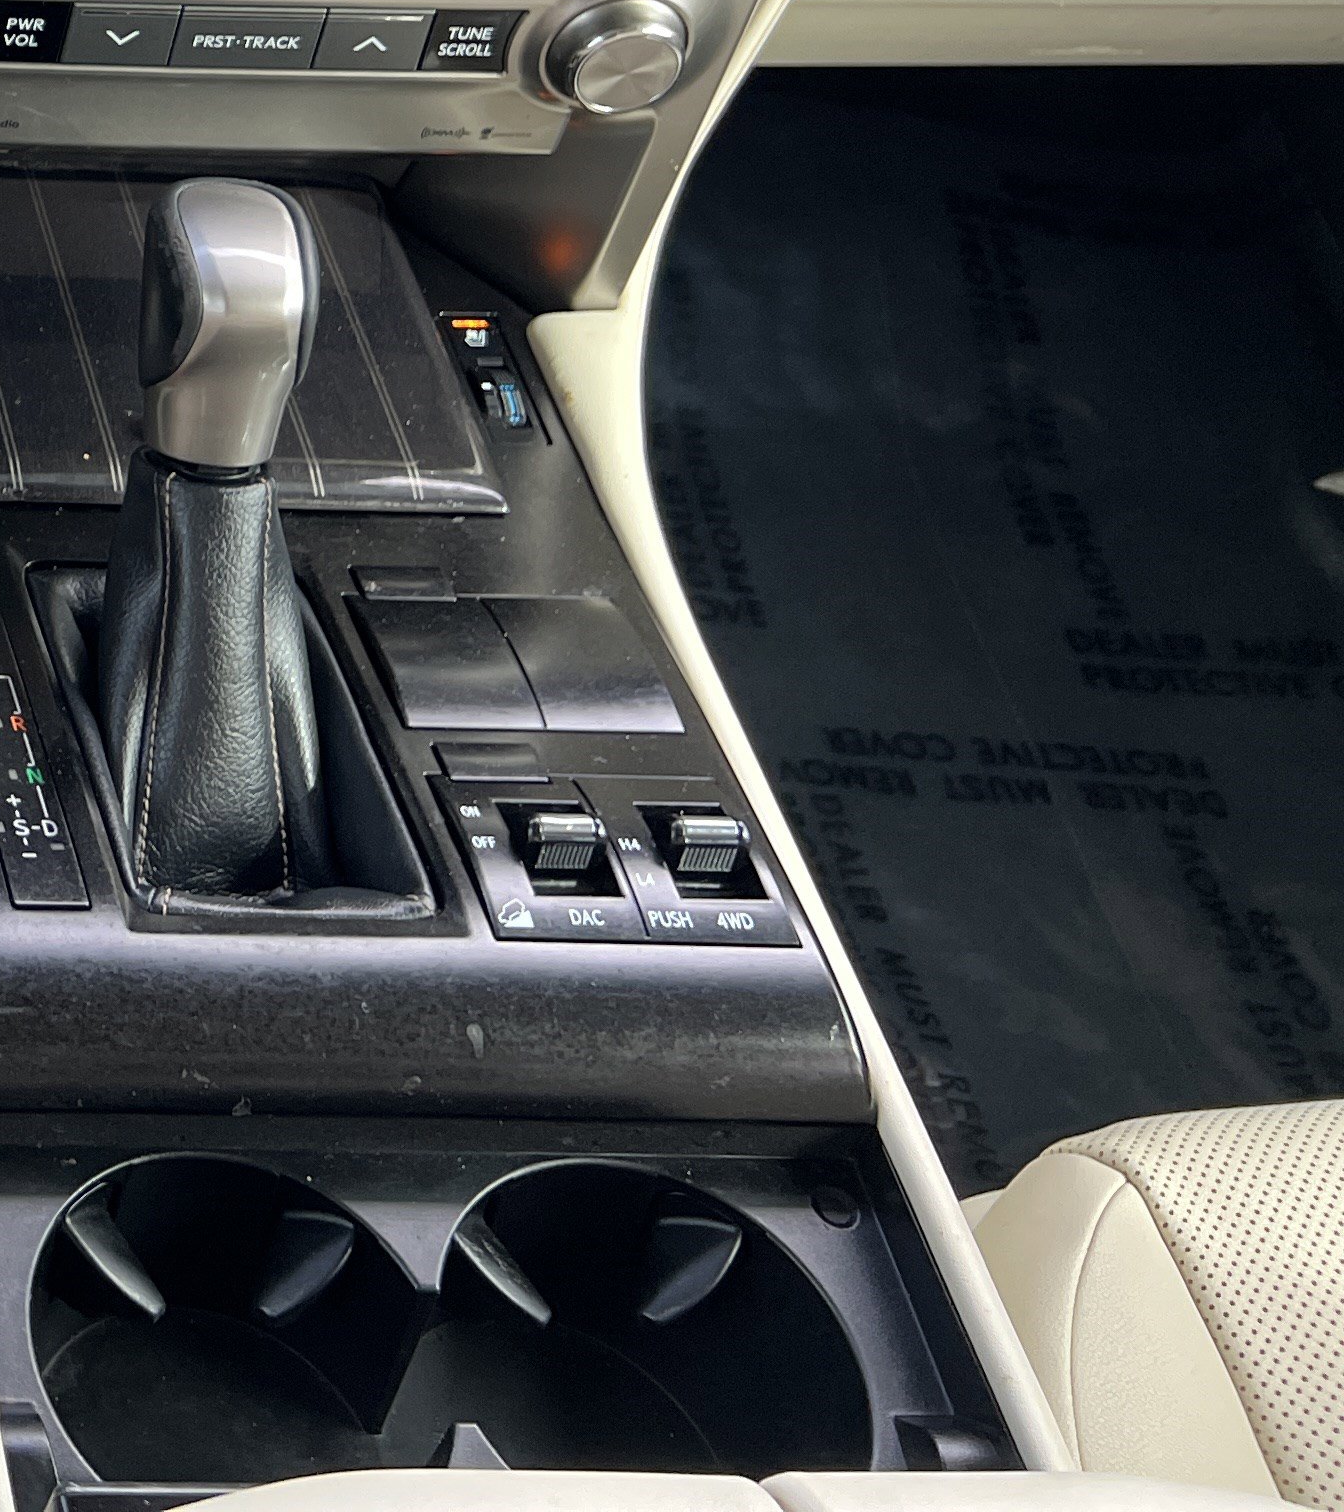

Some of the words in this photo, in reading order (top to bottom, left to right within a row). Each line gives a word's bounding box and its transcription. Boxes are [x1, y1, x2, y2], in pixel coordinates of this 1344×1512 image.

[6, 16, 45, 33] PWR
[4, 33, 39, 48] VOL
[448, 25, 494, 42] TUNE
[437, 41, 493, 58] SCROLL
[10, 715, 27, 732] R
[26, 767, 45, 785] N
[459, 804, 481, 819] ON
[471, 835, 496, 850] OFF
[618, 837, 642, 853] H4
[635, 872, 656, 887] L4
[568, 908, 606, 926] DAC
[648, 910, 694, 928] PUSH
[716, 911, 754, 930] 4WD
